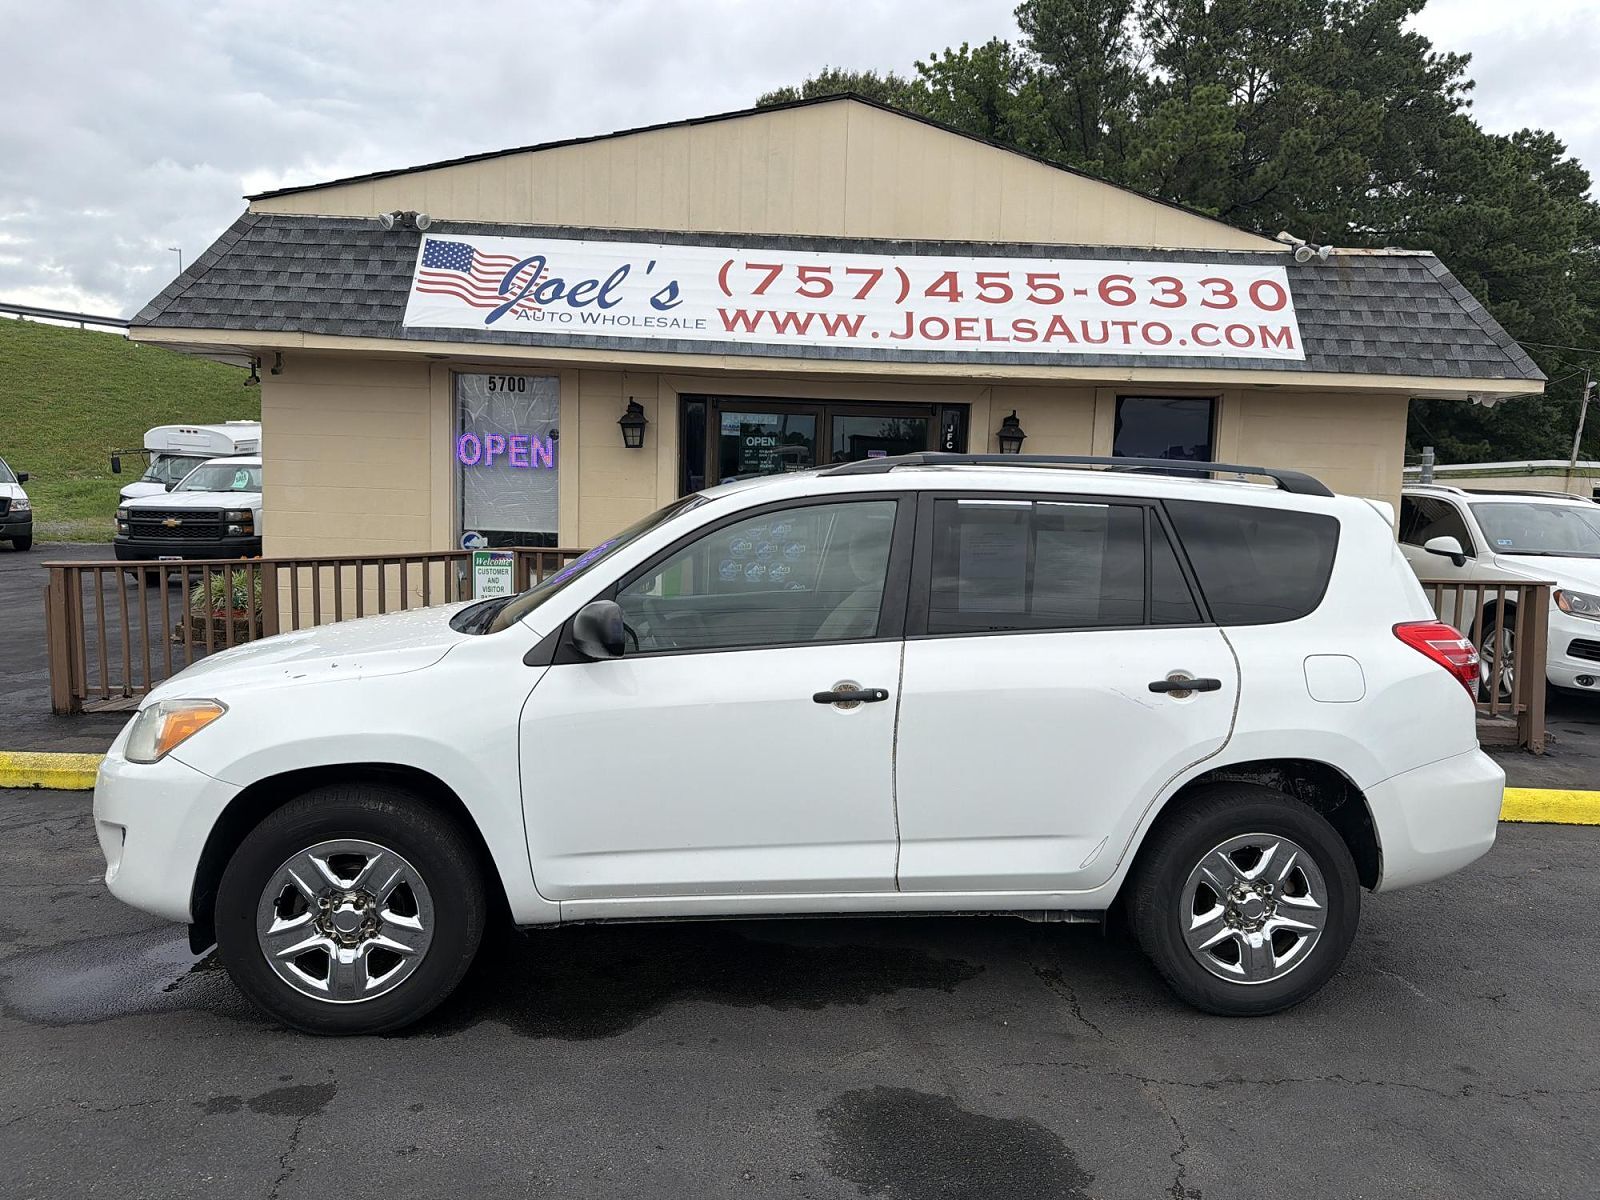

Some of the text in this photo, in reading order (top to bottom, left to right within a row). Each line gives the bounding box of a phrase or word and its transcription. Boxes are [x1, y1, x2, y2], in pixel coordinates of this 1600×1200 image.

[484, 254, 684, 325] Joel's
[717, 259, 1287, 312] (757)455-6330
[516, 308, 707, 331] AUTO WHOLESALE
[488, 376, 526, 392] 5700
[457, 432, 554, 468] OPEN
[745, 436, 776, 447] OPEN
[475, 557, 511, 566] Welcome
[477, 568, 509, 576] CUSTOMER
